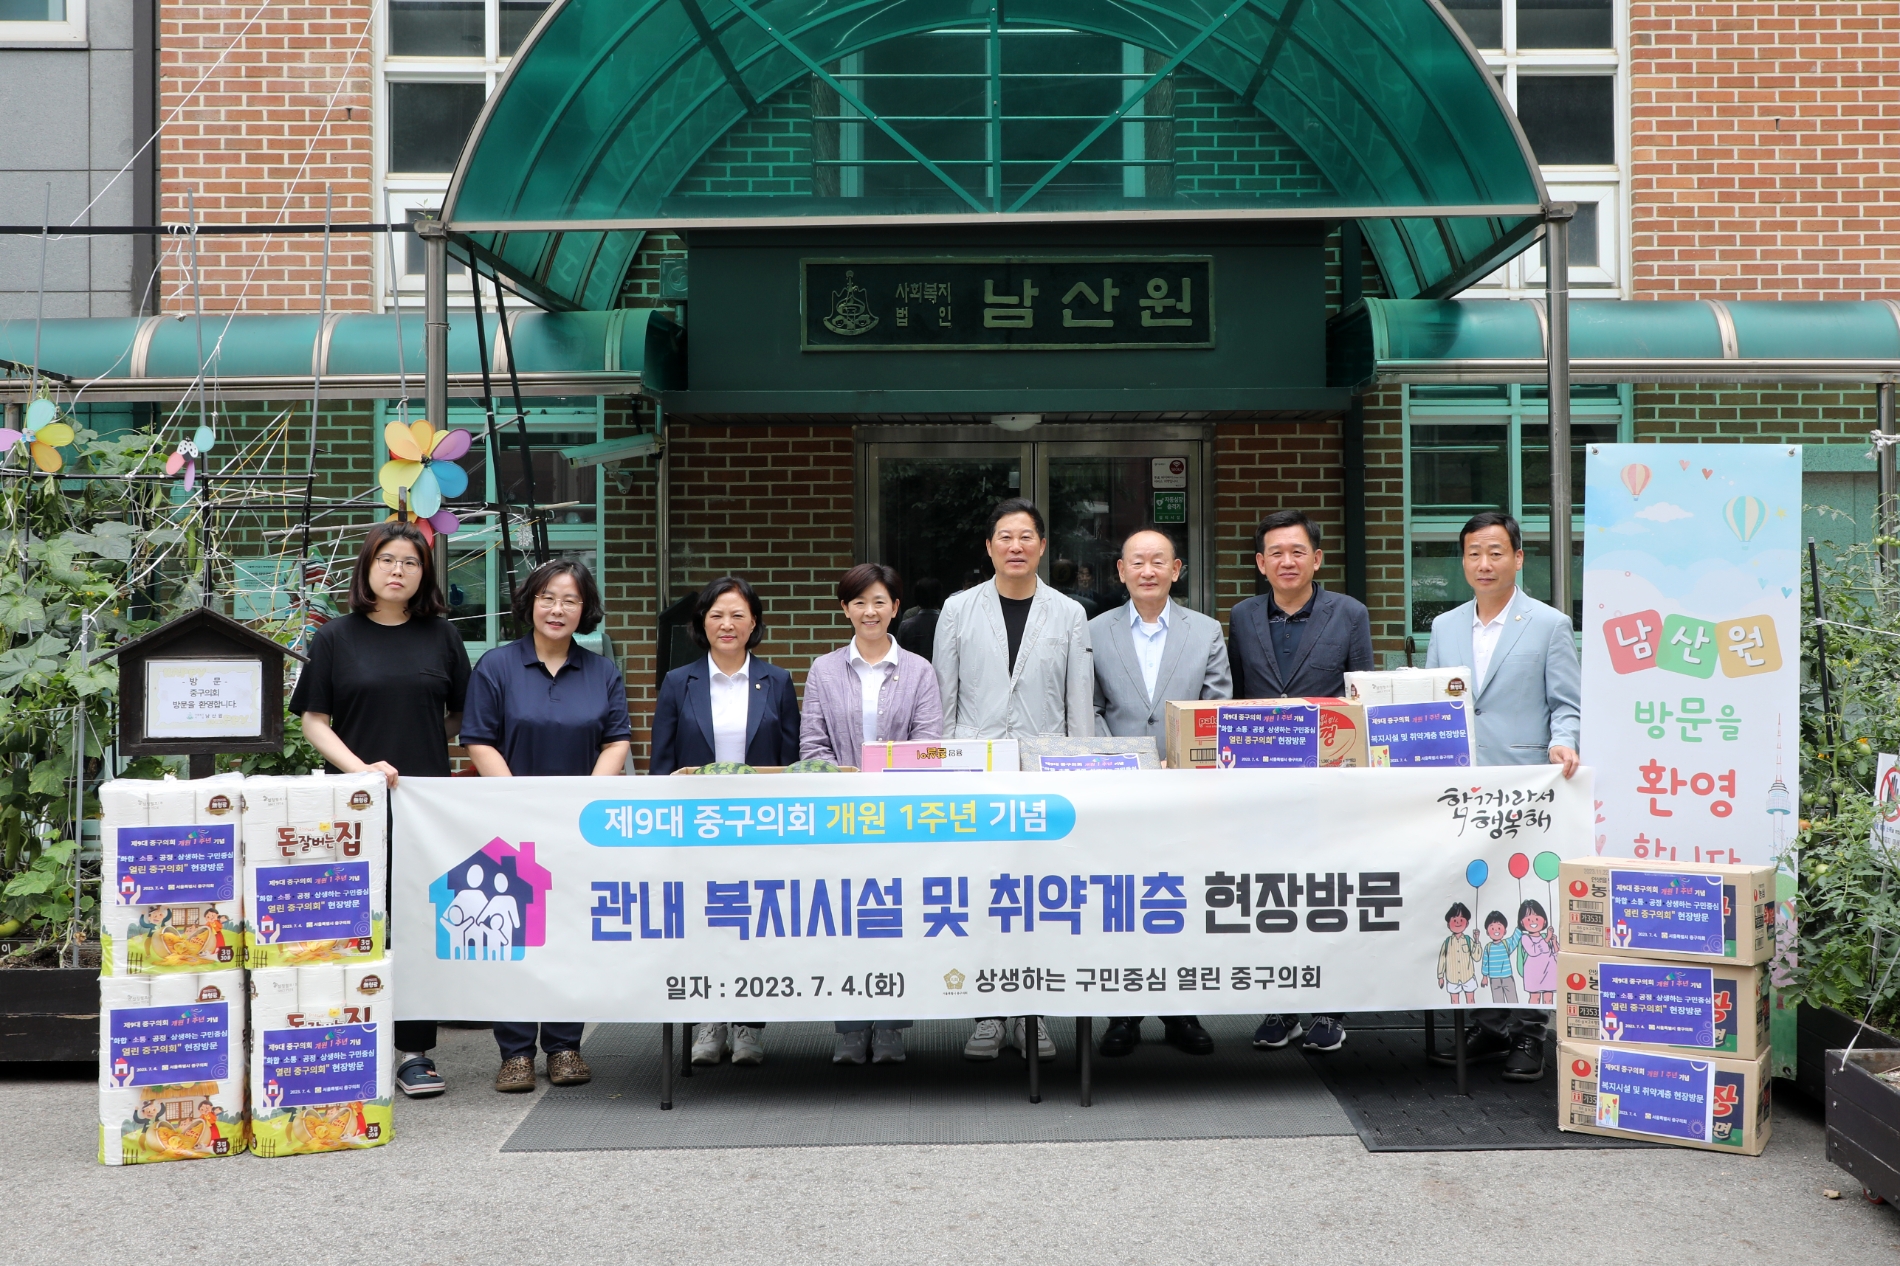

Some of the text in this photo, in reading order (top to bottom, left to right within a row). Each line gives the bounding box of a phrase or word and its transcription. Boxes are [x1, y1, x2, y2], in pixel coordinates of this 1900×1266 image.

[896, 281, 951, 305] 사회복지
[983, 277, 1193, 328] 남산원
[1615, 619, 1765, 667] 남산원
[190, 689, 219, 697] 중구의회
[173, 701, 194, 709] 방문을
[1388, 716, 1409, 724] 중구의회
[1634, 697, 1742, 743] 방문을
[1229, 736, 1242, 744] 열린
[1278, 737, 1306, 745] 현장방문
[1371, 734, 1399, 743] 복지시설
[1410, 732, 1437, 740] 취약계층
[1439, 730, 1466, 738] 현장방문
[1636, 758, 1736, 818] 환영
[604, 799, 1047, 838] 제9대 중구의회 개원 1주년 기념
[1471, 809, 1551, 839] 행복해
[129, 866, 146, 874] 열린
[191, 863, 224, 872] 현장방문
[1634, 885, 1658, 893] 중구의회
[268, 905, 284, 913] 열린
[328, 900, 360, 909] 현장방문
[591, 871, 1403, 941] 관내 복지시설 및 취약계층 현장방문
[1666, 900, 1692, 908] 상생하는
[1624, 909, 1639, 917] 열린
[1678, 912, 1709, 922] 현장방문
[976, 965, 1321, 992] 상생하는 구민중심 열린 중구의회
[666, 976, 712, 1000] 일자
[734, 976, 801, 998] 2023.
[811, 976, 832, 996] 7.
[841, 972, 904, 998] 4.(화)
[1611, 1003, 1627, 1011] 열린
[1670, 1006, 1702, 1015] 현장방문
[122, 1047, 139, 1056] 열린
[185, 1042, 218, 1051] 현장방문
[286, 1042, 312, 1050] 중구의회
[320, 1052, 347, 1061] 상생하는
[276, 1067, 291, 1077] 열린
[332, 1062, 364, 1072] 현장방문
[1621, 1065, 1644, 1075] 중구의회
[1601, 1081, 1704, 1103] 복지시설 및 취약계층 현장방문
